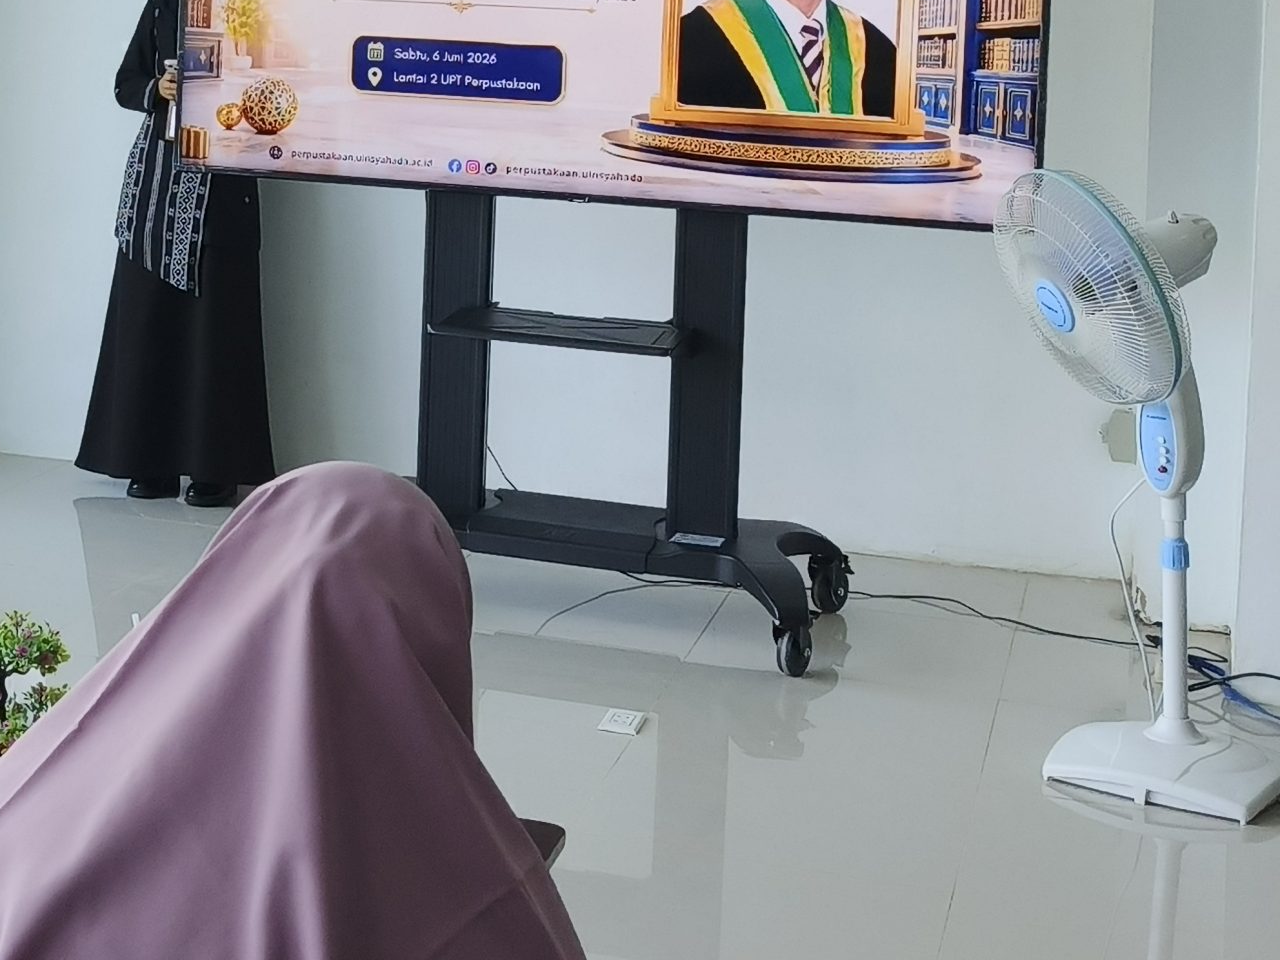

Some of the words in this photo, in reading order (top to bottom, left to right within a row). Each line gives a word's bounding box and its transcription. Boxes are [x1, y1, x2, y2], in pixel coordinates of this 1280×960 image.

[393, 47, 430, 62] Sabtu,
[432, 50, 440, 61] 6
[442, 51, 464, 64] Juni
[466, 52, 498, 65] 2026
[393, 71, 427, 84] Lantai
[430, 73, 438, 85] 2
[441, 73, 463, 87] UPT
[464, 75, 541, 91] Perpustakaan
